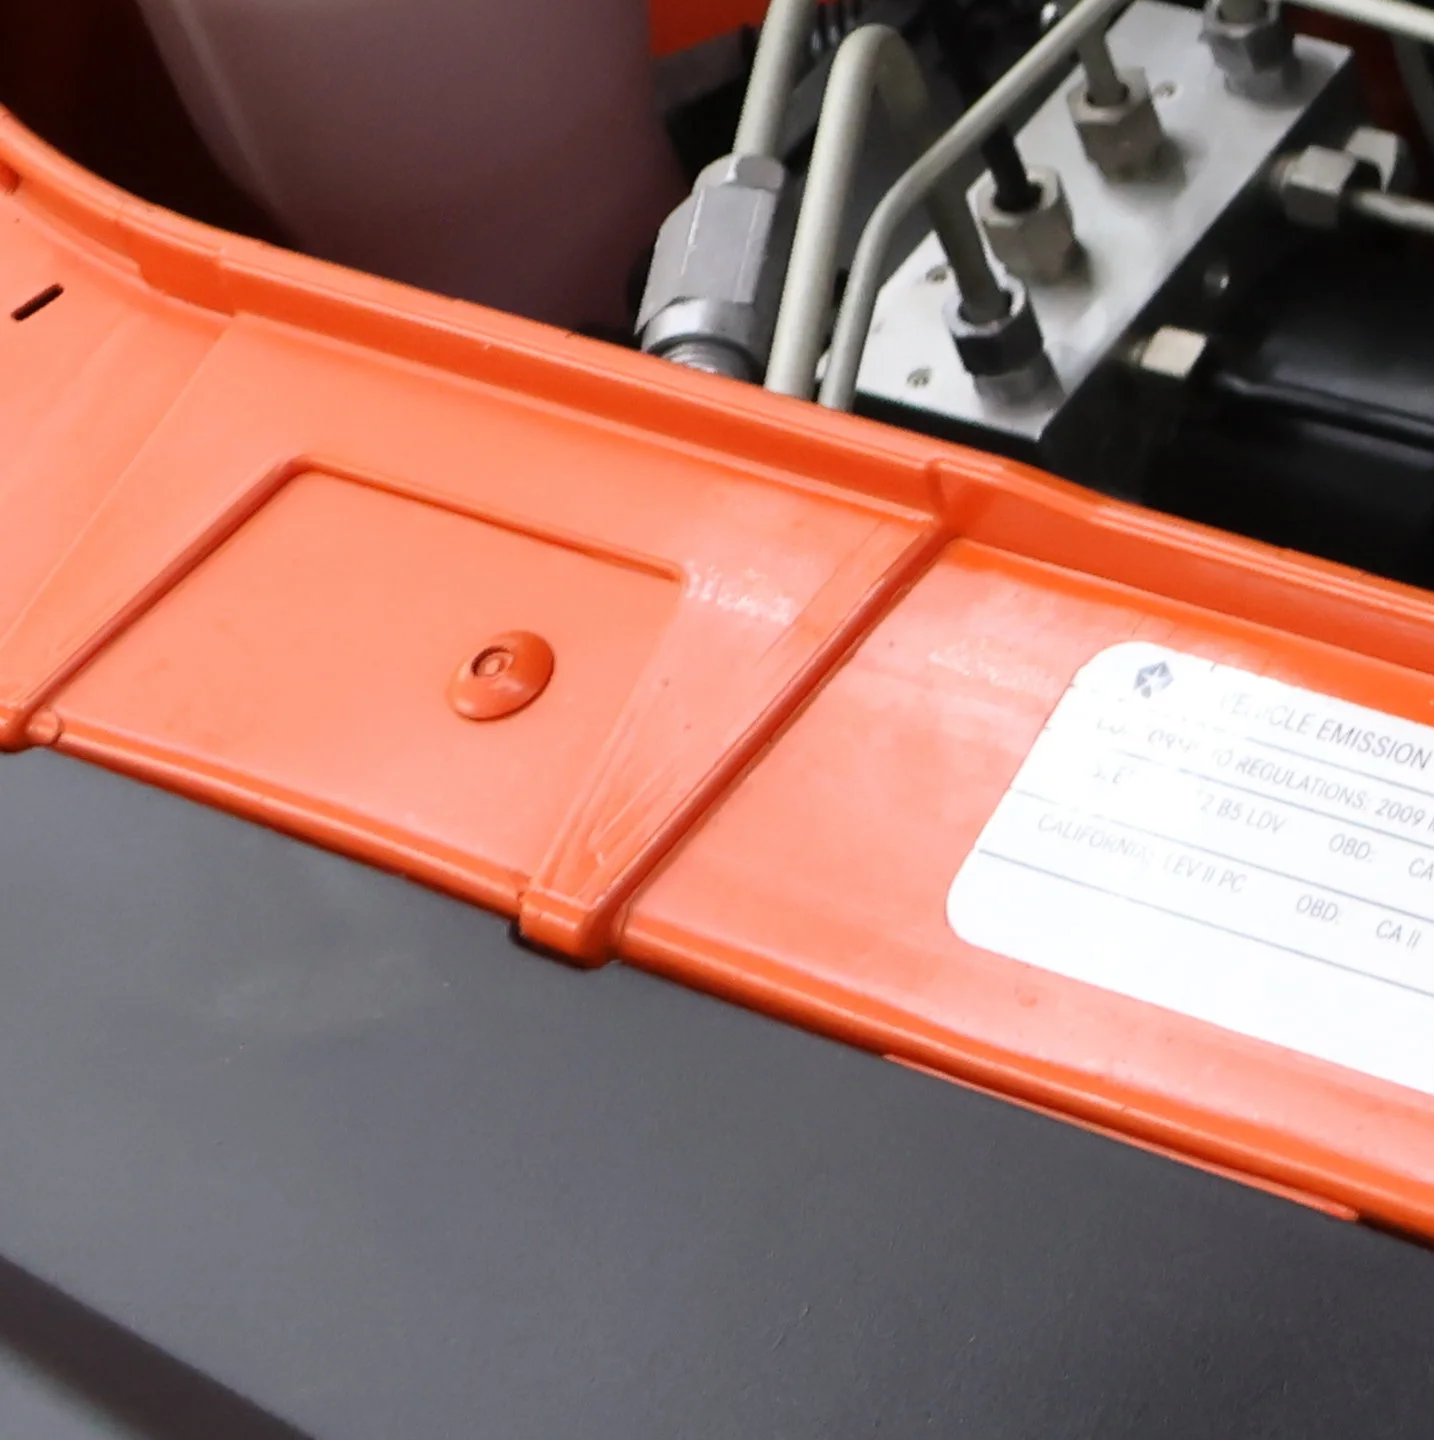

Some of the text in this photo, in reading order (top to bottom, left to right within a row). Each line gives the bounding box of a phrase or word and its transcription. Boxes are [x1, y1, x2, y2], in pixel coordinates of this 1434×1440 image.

[1316, 719, 1433, 771] EMISSION
[1235, 757, 1370, 812] REGULATIONS:
[1375, 797, 1427, 826] 2009
[1245, 809, 1287, 834] LDV
[1037, 812, 1155, 866] CALIFORNIA:
[1217, 868, 1248, 894] PC
[1328, 833, 1375, 865] OBD:
[1295, 893, 1343, 925] OBD:
[1375, 919, 1403, 944] CA
